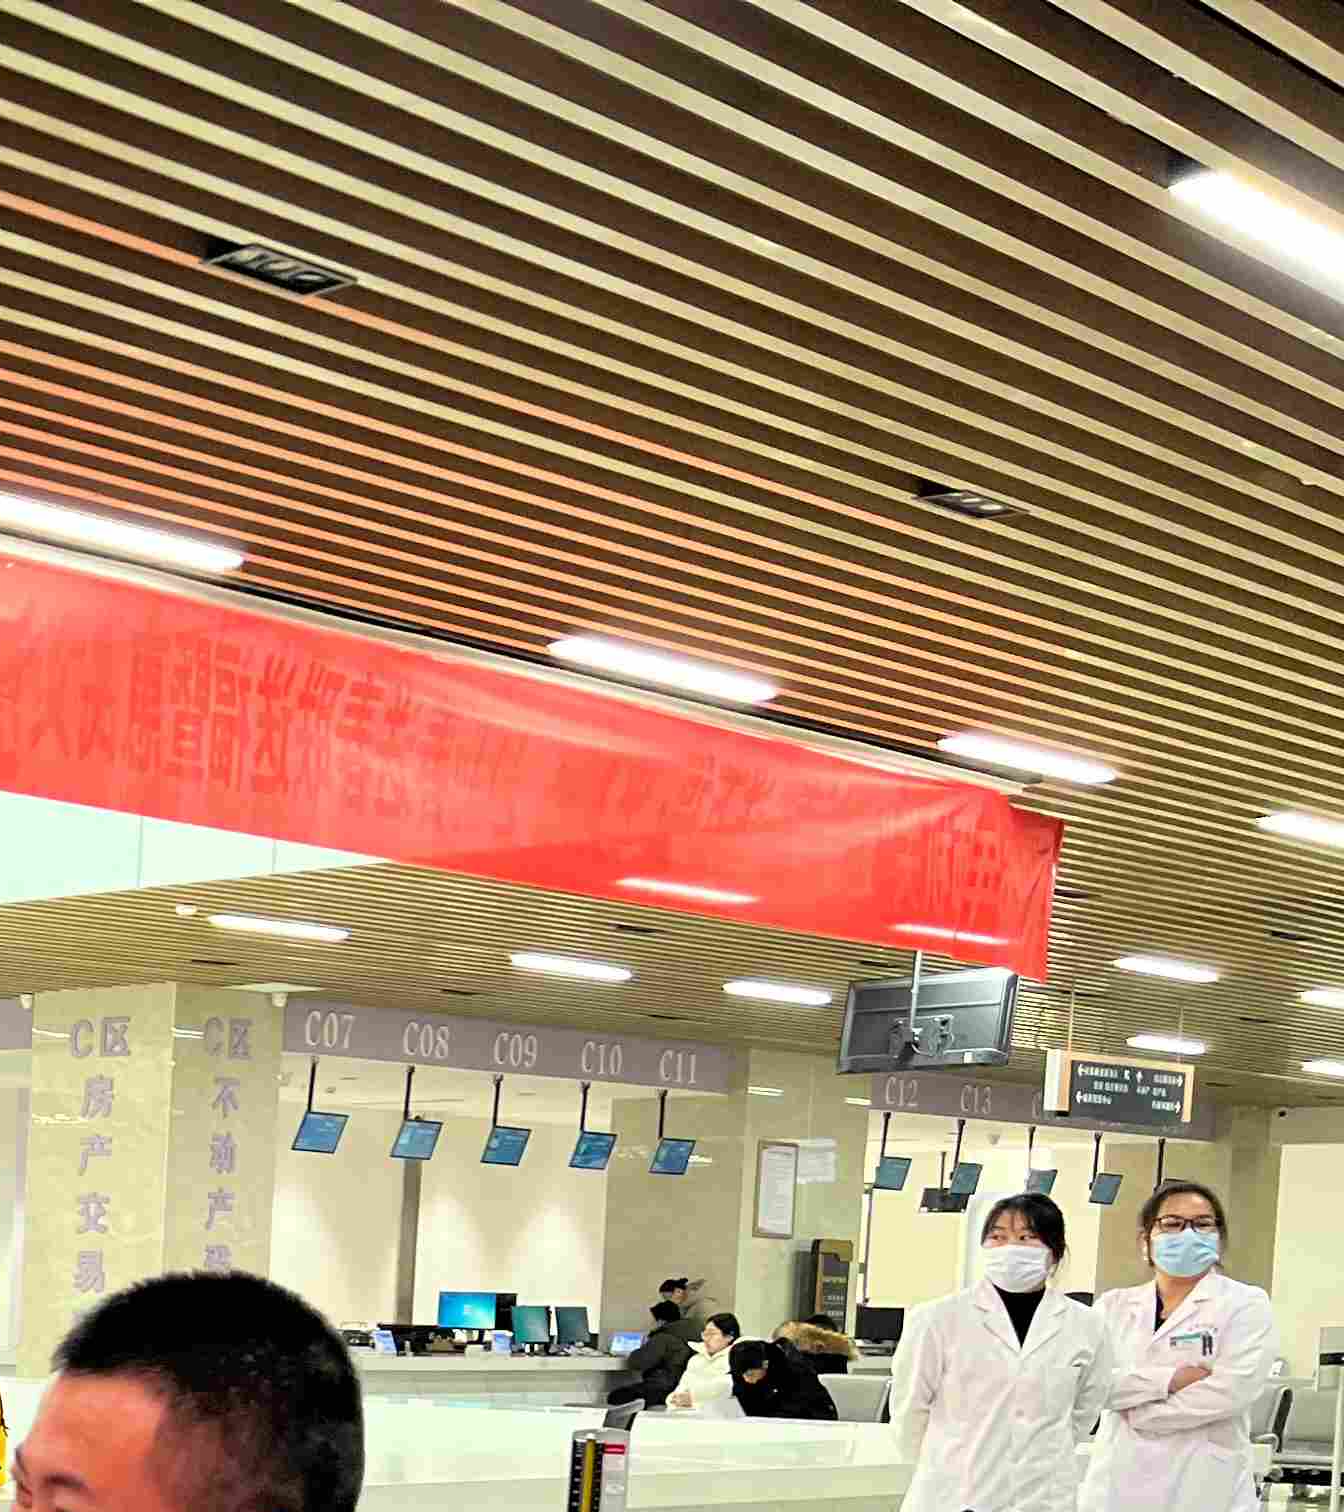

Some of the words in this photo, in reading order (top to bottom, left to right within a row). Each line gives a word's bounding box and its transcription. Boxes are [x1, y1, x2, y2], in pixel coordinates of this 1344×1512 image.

[71, 1016, 132, 1059] C区
[204, 1017, 253, 1061] C区
[304, 1010, 356, 1050] C07
[402, 1021, 450, 1060] C08
[493, 1032, 538, 1068] C09
[581, 1041, 623, 1075] C10
[658, 1050, 698, 1084] C11
[885, 1075, 919, 1107] C12
[961, 1084, 993, 1114] C13
[73, 1073, 114, 1293] 房产交易
